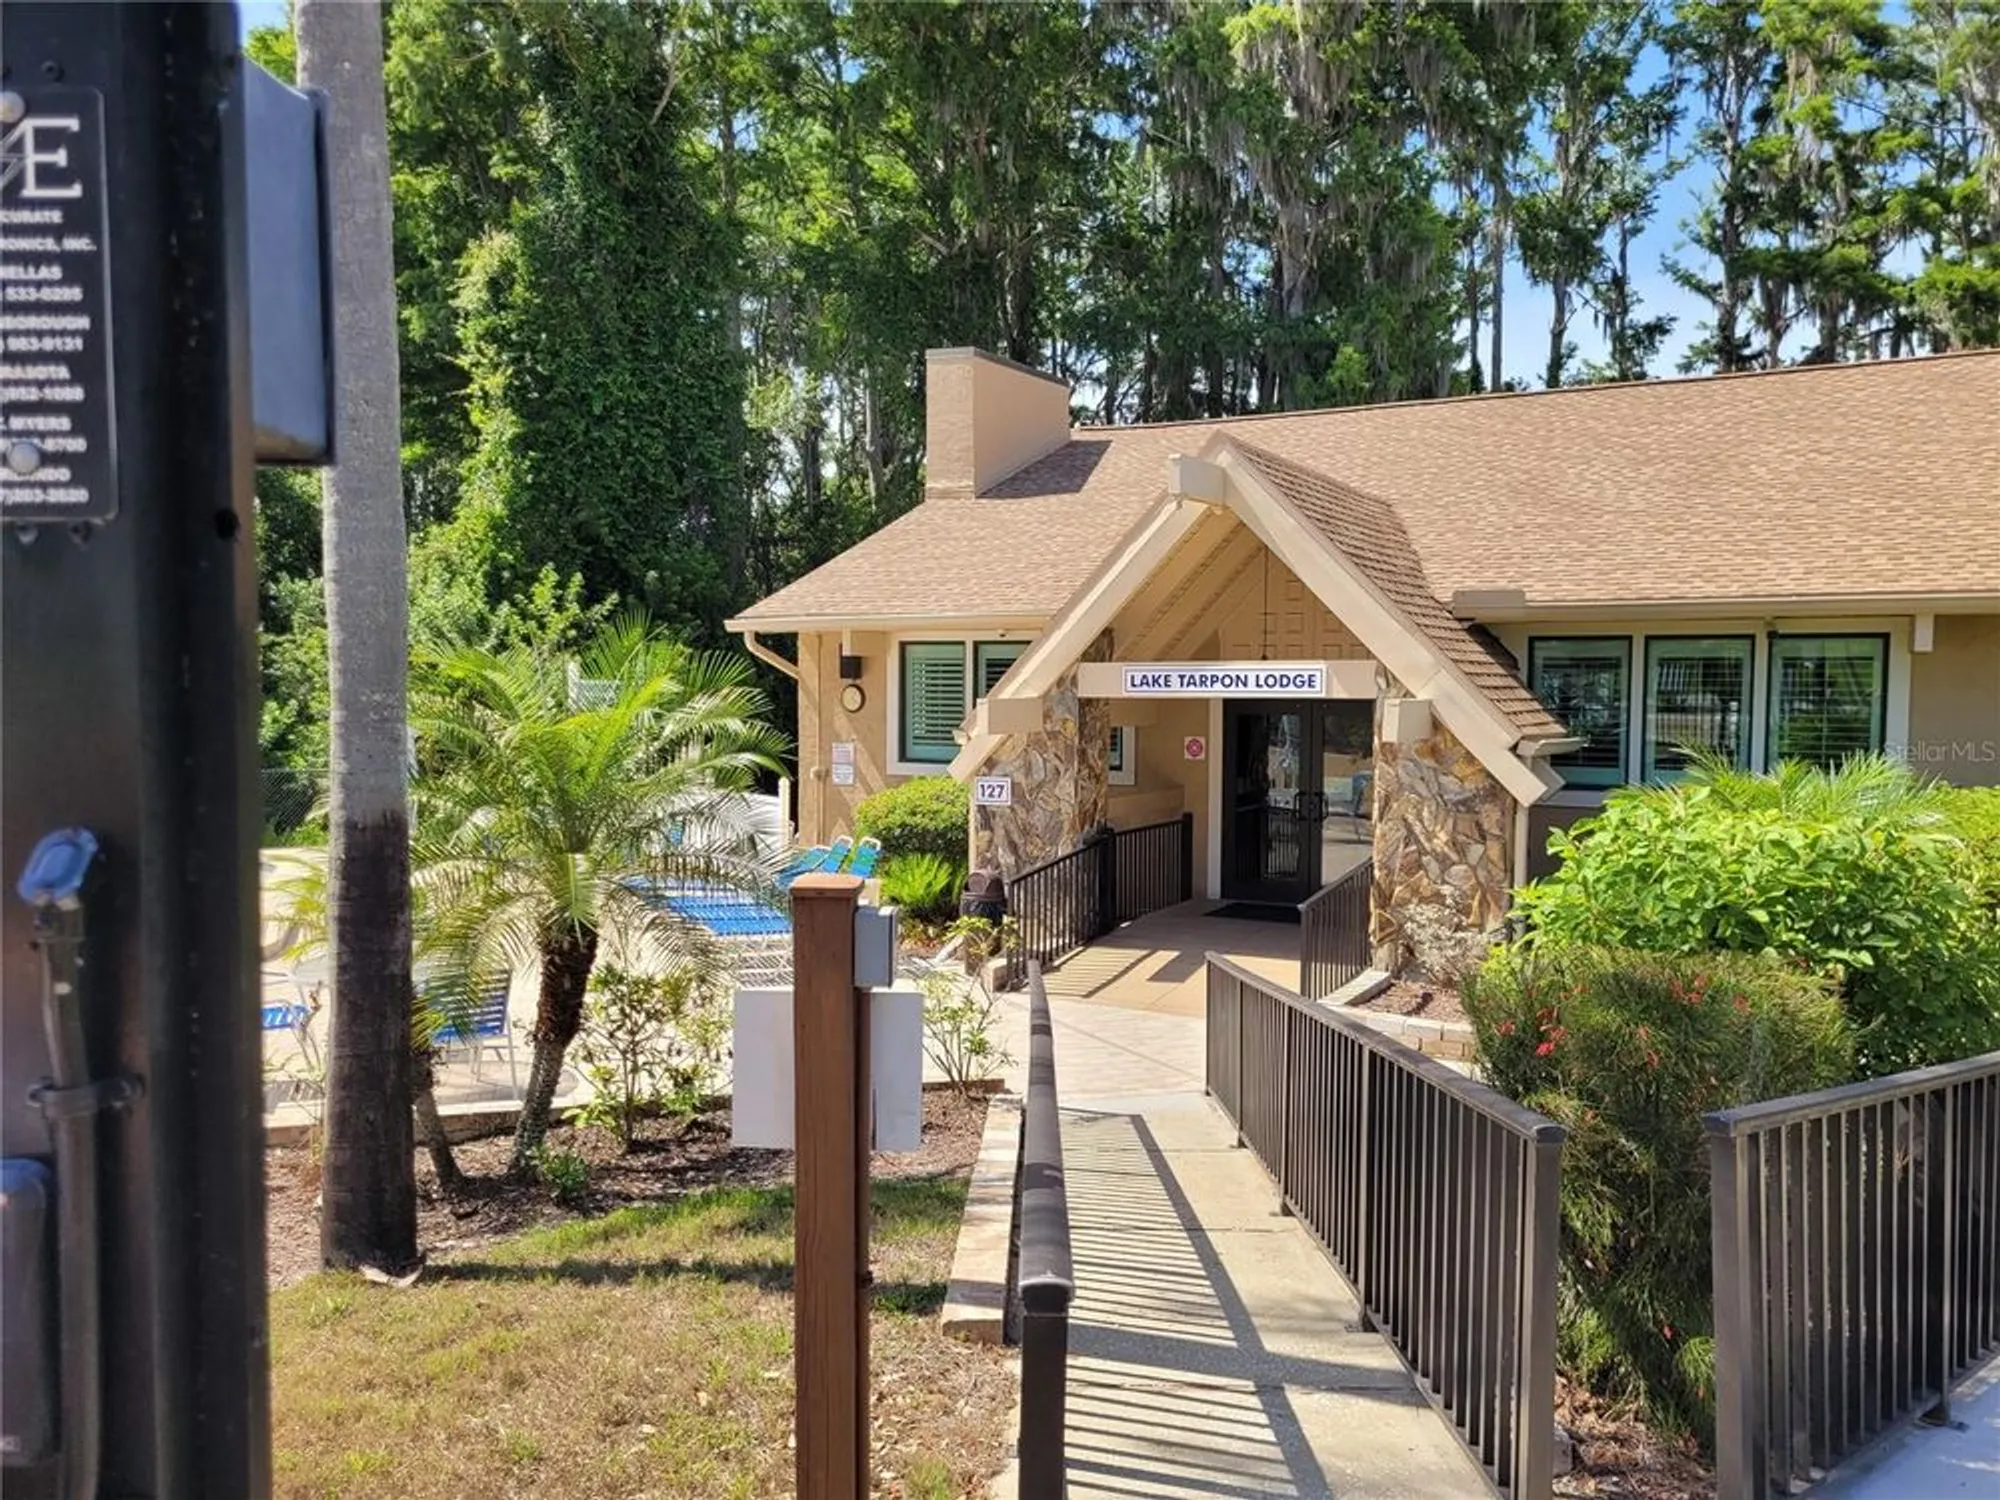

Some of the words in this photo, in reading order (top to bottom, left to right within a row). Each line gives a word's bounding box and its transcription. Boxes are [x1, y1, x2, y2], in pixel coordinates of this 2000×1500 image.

[1130, 674, 1172, 689] LAKE
[1178, 674, 1249, 689] TARPON
[1255, 674, 1317, 689] LODGE
[980, 784, 1005, 799] 127
